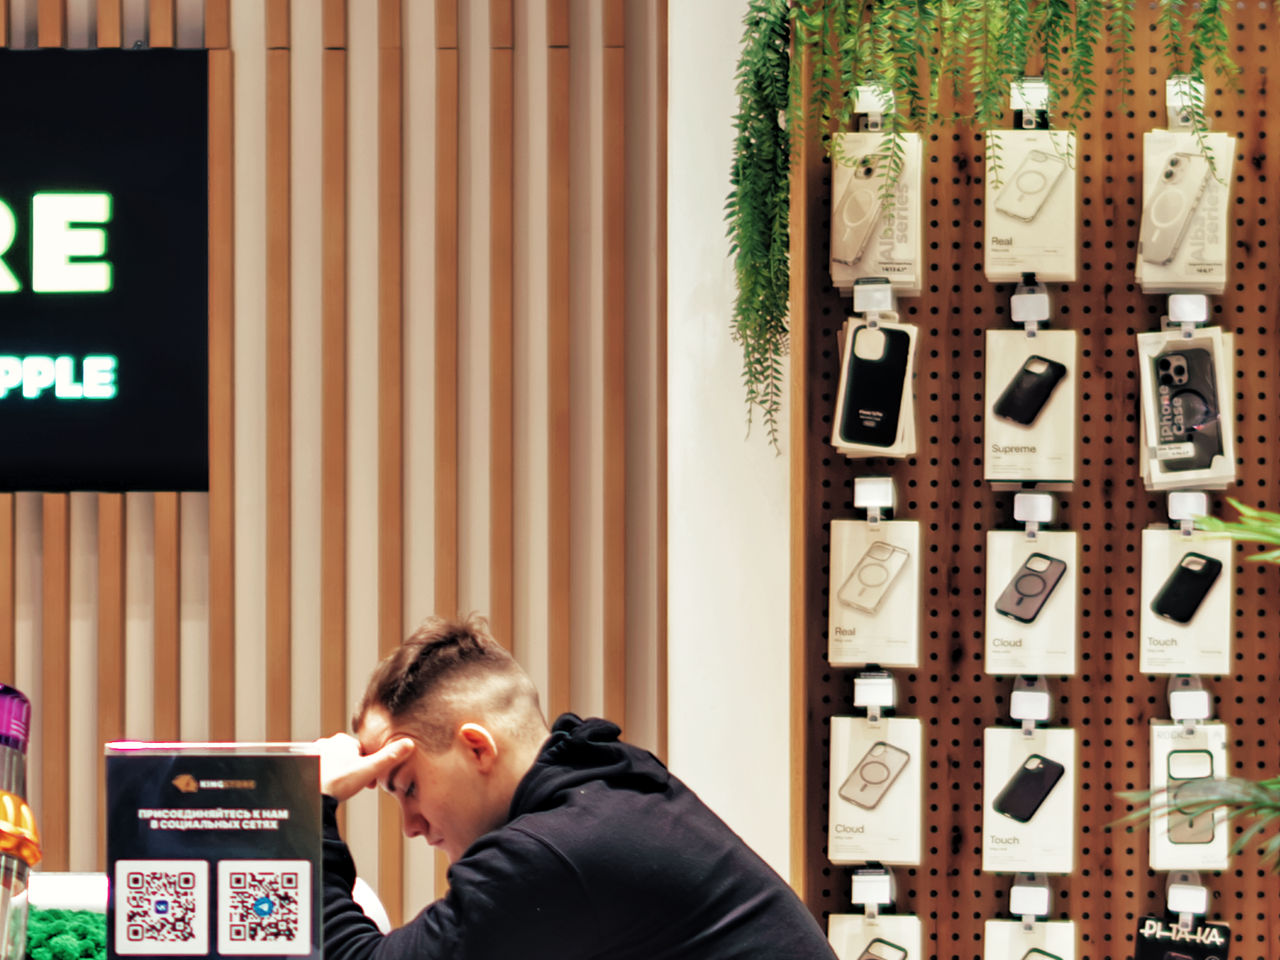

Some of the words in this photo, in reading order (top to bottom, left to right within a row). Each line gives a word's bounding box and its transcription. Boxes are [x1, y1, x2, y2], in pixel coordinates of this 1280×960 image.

[991, 236, 1013, 247] Real
[1159, 385, 1174, 442] iPhone
[1172, 397, 1185, 436] Case
[991, 444, 1037, 457] Supreme
[834, 626, 856, 638] Real
[992, 637, 1023, 649] Cloud
[1147, 636, 1178, 648] Touch
[138, 808, 252, 820] ПРИСОЕДИНЯЙТЕСЬ
[253, 809, 261, 820] К
[262, 809, 290, 820] НАМ
[150, 819, 159, 830] В
[159, 819, 241, 831] СОЦИАЛЬНЫХ
[241, 819, 279, 830] СЕТЯХ
[834, 823, 865, 835] Cloud
[990, 834, 1020, 846] Touch
